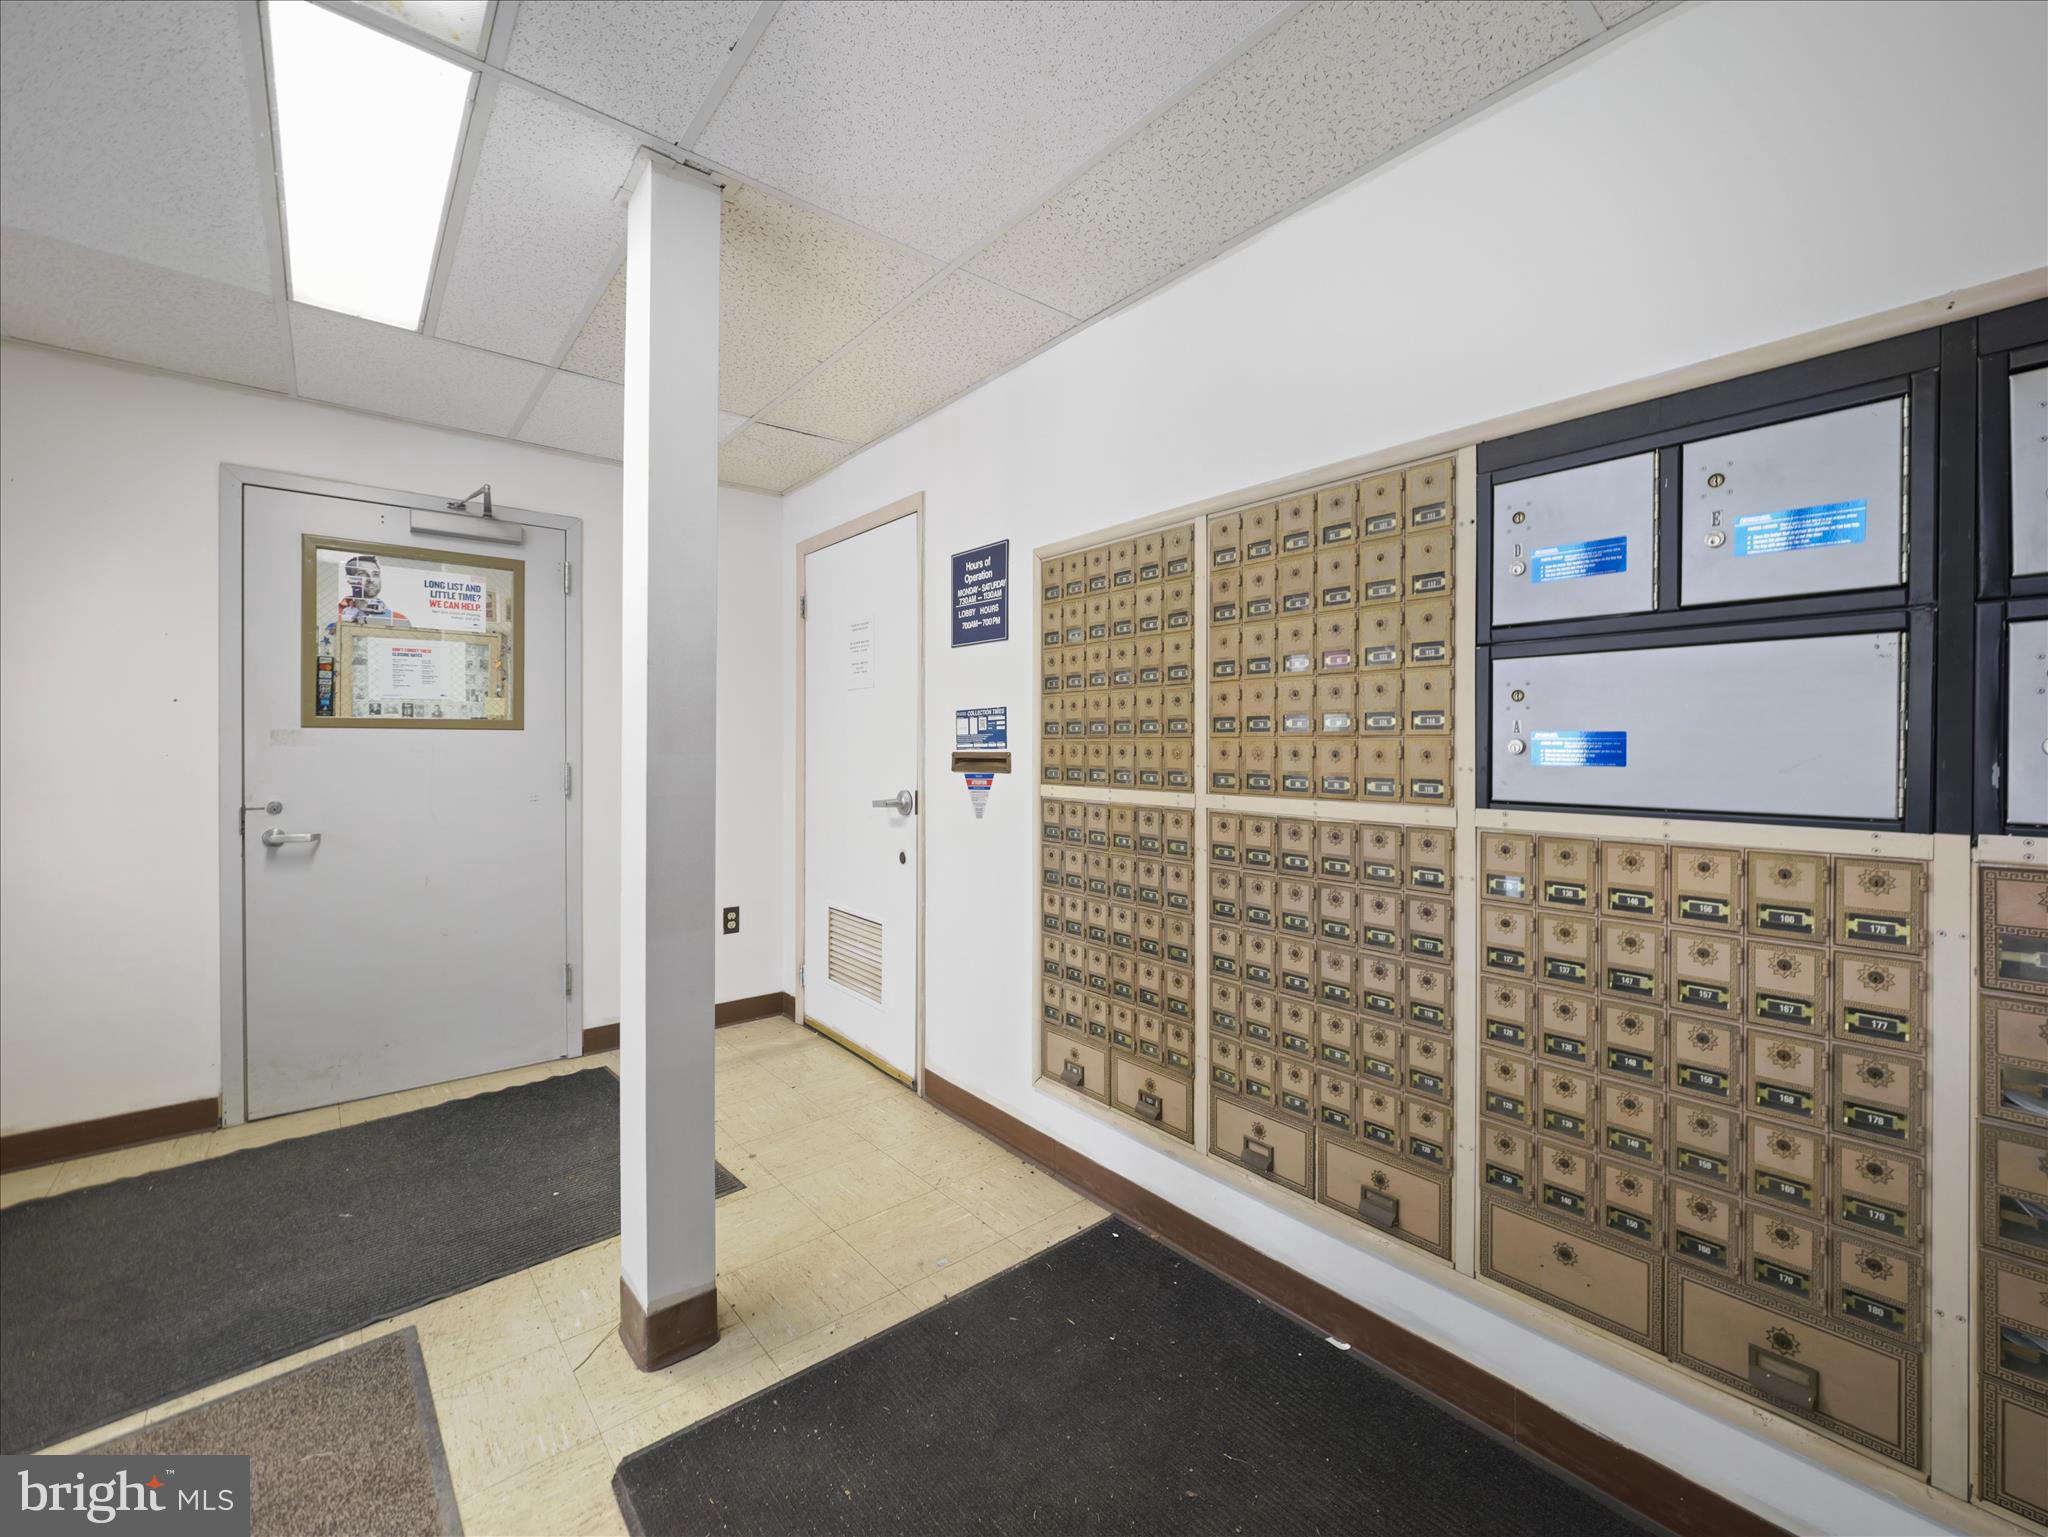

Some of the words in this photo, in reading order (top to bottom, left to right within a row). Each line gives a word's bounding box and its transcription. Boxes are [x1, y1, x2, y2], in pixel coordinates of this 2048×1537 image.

[1712, 510, 1721, 527] E
[1514, 544, 1521, 557] D
[966, 560, 983, 571] Hours
[984, 556, 991, 566] of
[964, 569, 993, 584] Operation
[424, 580, 445, 590] LONG
[447, 582, 464, 592] LIST
[465, 584, 481, 593] AND
[958, 585, 978, 597] MONDAY
[982, 578, 1007, 592] SATURDAY
[430, 590, 456, 600] LITTLE
[458, 592, 481, 602] TIME?
[429, 599, 442, 608] WE
[444, 601, 460, 610] CAN
[958, 608, 976, 618] LOBBY
[980, 604, 999, 615] HOURS
[967, 709, 992, 717] COLLECTION
[1513, 720, 1520, 733] A
[1780, 915, 1794, 923] 166
[1870, 925, 1887, 934] 176
[1780, 1005, 1794, 1013] 167
[1872, 1020, 1888, 1029] 177
[1780, 1094, 1794, 1104] 168
[1868, 1115, 1884, 1125] 178
[1781, 1184, 1795, 1194] 169
[1869, 1210, 1885, 1220] 179
[1779, 1274, 1793, 1284] 170
[1868, 1305, 1883, 1316] 180
